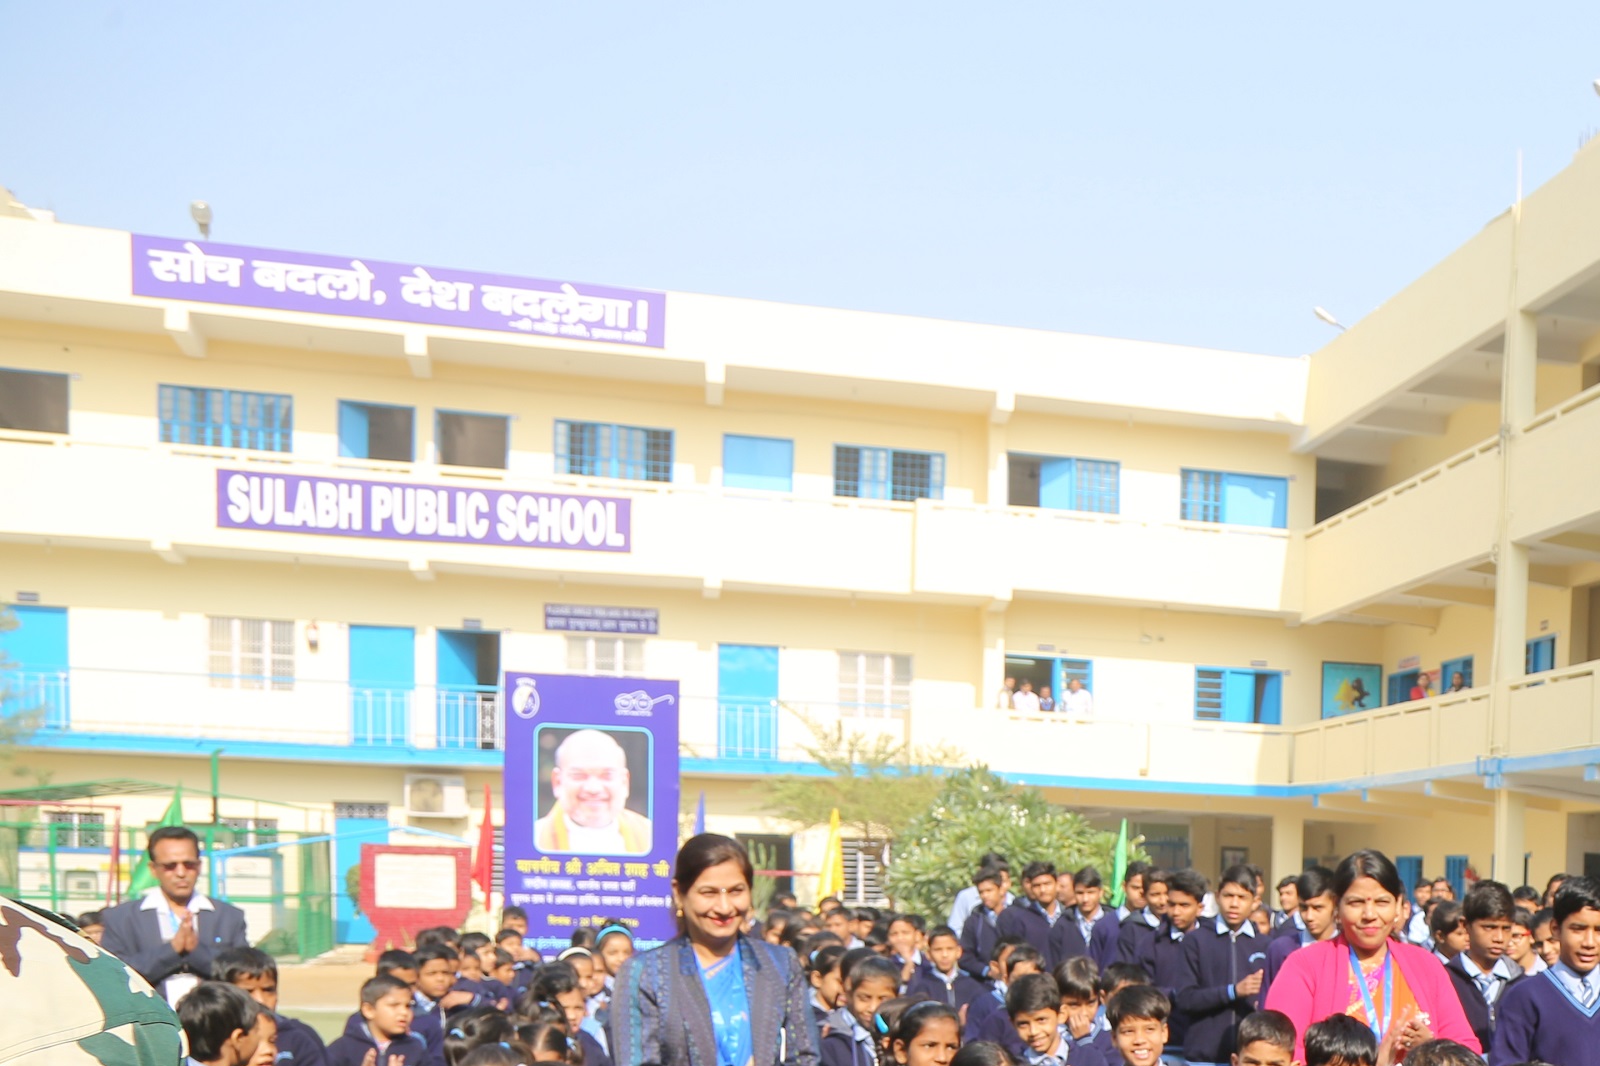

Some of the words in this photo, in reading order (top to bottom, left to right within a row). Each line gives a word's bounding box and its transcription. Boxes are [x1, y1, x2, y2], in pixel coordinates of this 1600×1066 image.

[147, 242, 244, 288] सोच
[251, 259, 387, 305] बदलो,
[400, 266, 474, 311] देश
[226, 474, 362, 531] SULABH
[370, 484, 490, 539] PUBLIC
[495, 490, 625, 547] SCHOOL
